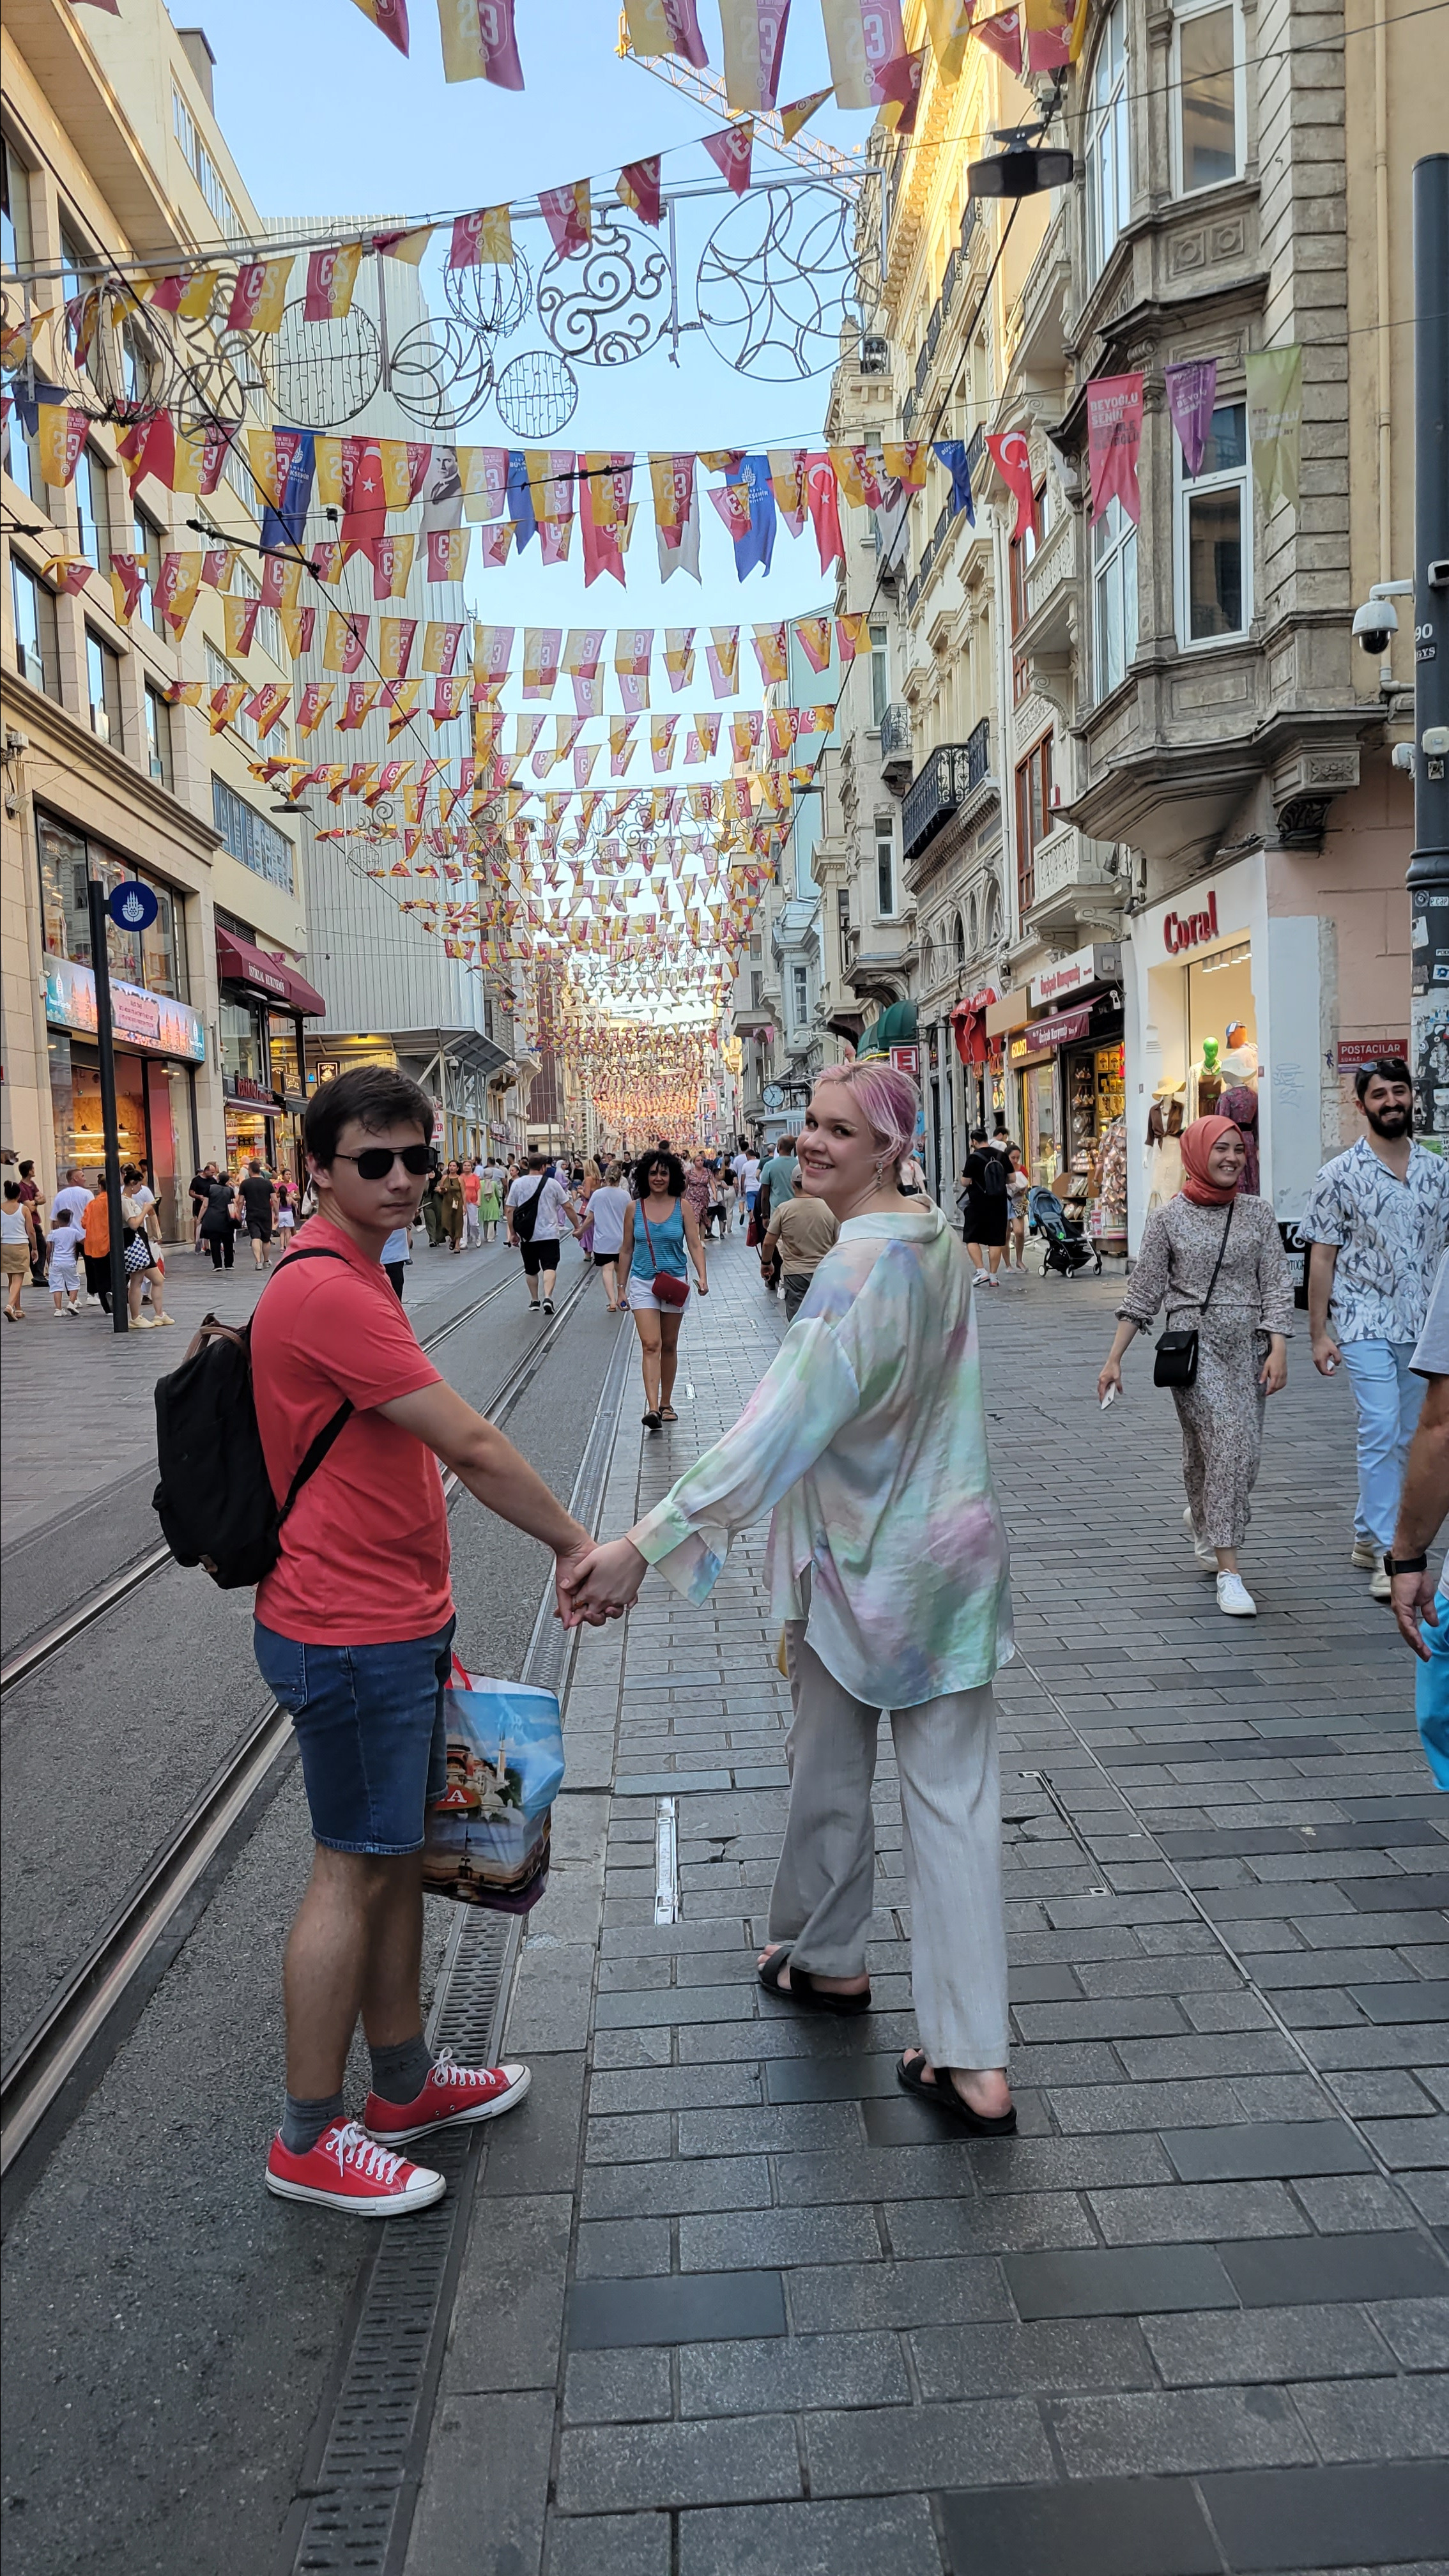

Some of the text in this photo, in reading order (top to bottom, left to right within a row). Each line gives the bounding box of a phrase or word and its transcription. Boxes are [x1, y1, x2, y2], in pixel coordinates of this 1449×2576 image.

[740, 17, 778, 65] 23
[843, 14, 887, 59] 23
[1090, 392, 1138, 412] BEYOĞLU
[1091, 409, 1123, 427] SENİN
[54, 430, 80, 461] 23
[329, 456, 353, 486] 23
[663, 473, 687, 499] 23
[1164, 891, 1219, 953] Coral
[1011, 1039, 1027, 1059] GOLDST
[1342, 1043, 1400, 1055] POSTACILAR
